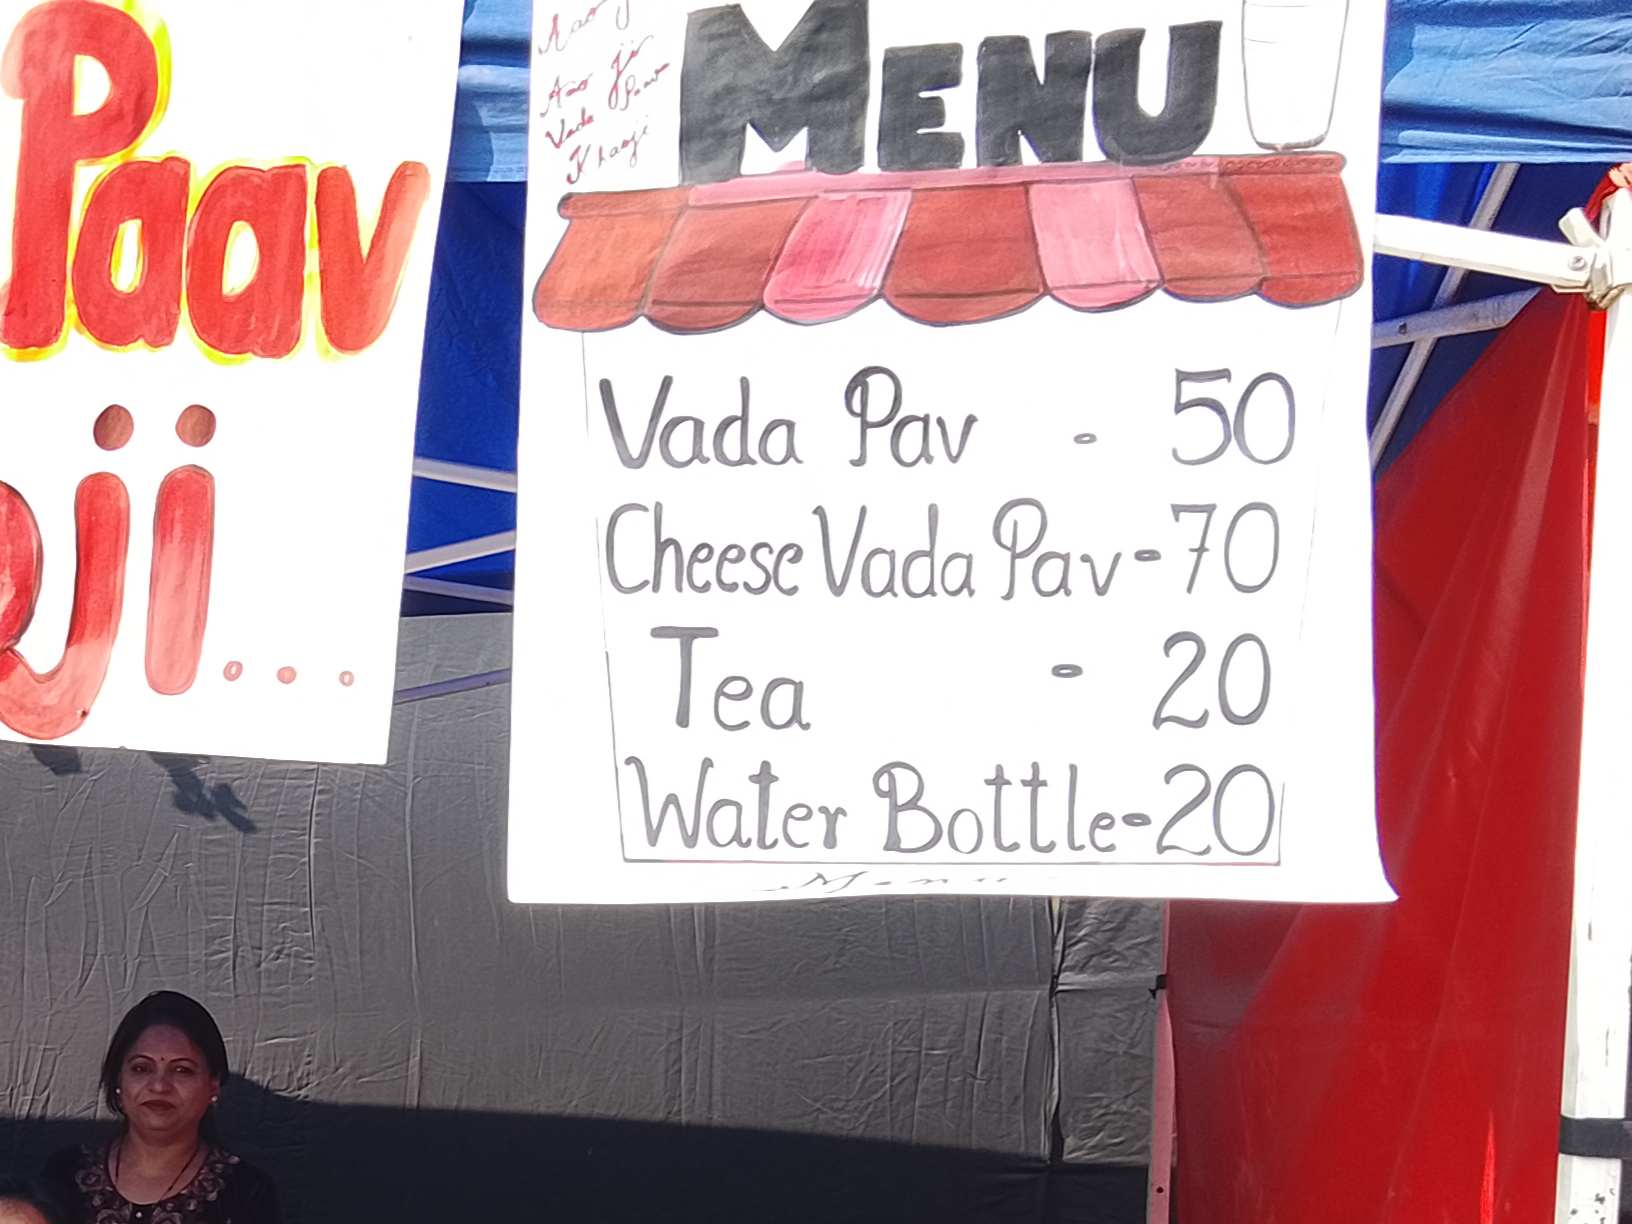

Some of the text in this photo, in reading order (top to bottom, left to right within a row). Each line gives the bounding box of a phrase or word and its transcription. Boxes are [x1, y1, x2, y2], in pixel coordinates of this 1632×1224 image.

[678, 0, 1222, 186] MENU
[599, 375, 803, 469] Vada
[844, 365, 979, 468] Pav
[1171, 367, 1296, 466] 50
[812, 504, 976, 599] Vada
[650, 625, 811, 732] Tea
[1152, 630, 1272, 730] 20
[625, 755, 847, 850] Water
